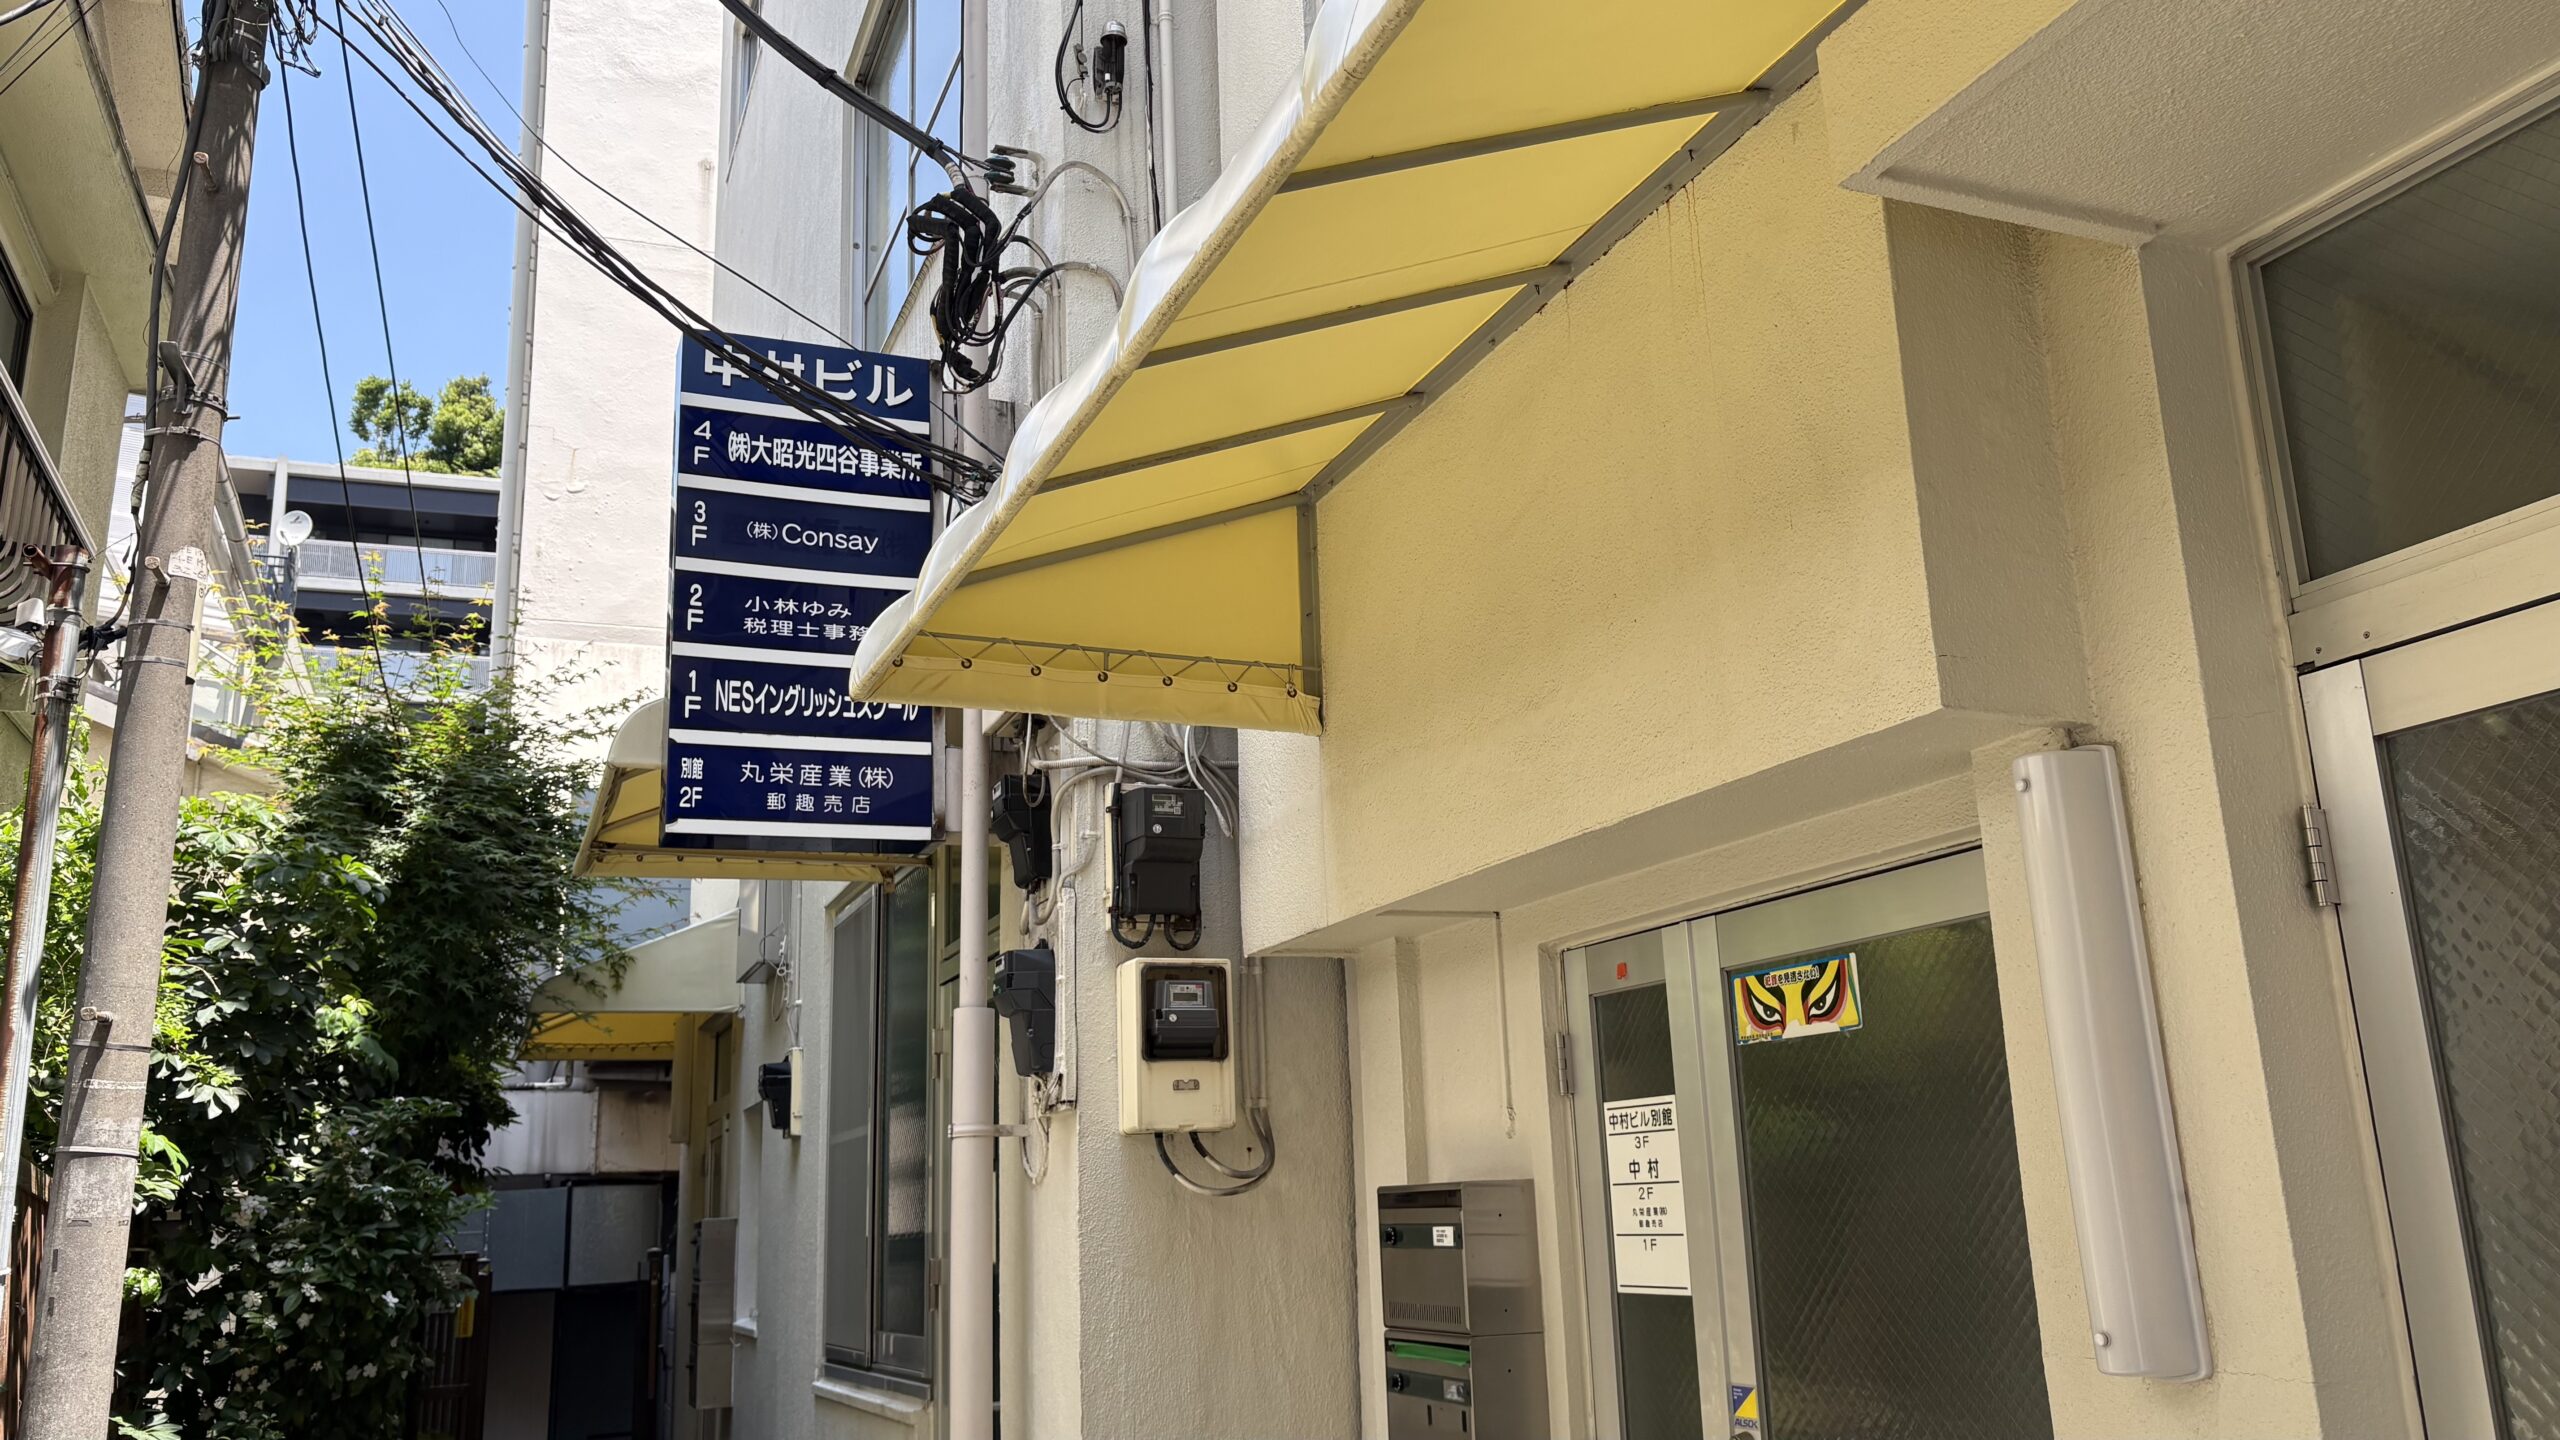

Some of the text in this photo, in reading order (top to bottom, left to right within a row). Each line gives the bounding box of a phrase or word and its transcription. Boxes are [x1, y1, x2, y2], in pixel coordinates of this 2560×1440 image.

[744, 595, 852, 619] 小林ゆみ
[680, 757, 704, 780] 別館
[740, 761, 894, 789] 丸栄産業(株)
[679, 786, 703, 808] 2F
[767, 792, 871, 814] 郵趣売店
[1608, 1106, 1673, 1131] 中村ビル別館
[1634, 1135, 1649, 1149] 3F
[1629, 1158, 1659, 1180] 中村
[1638, 1187, 1654, 1200] 2F
[1643, 1238, 1657, 1251] 1F
[1734, 1418, 1758, 1429] ALSOK
